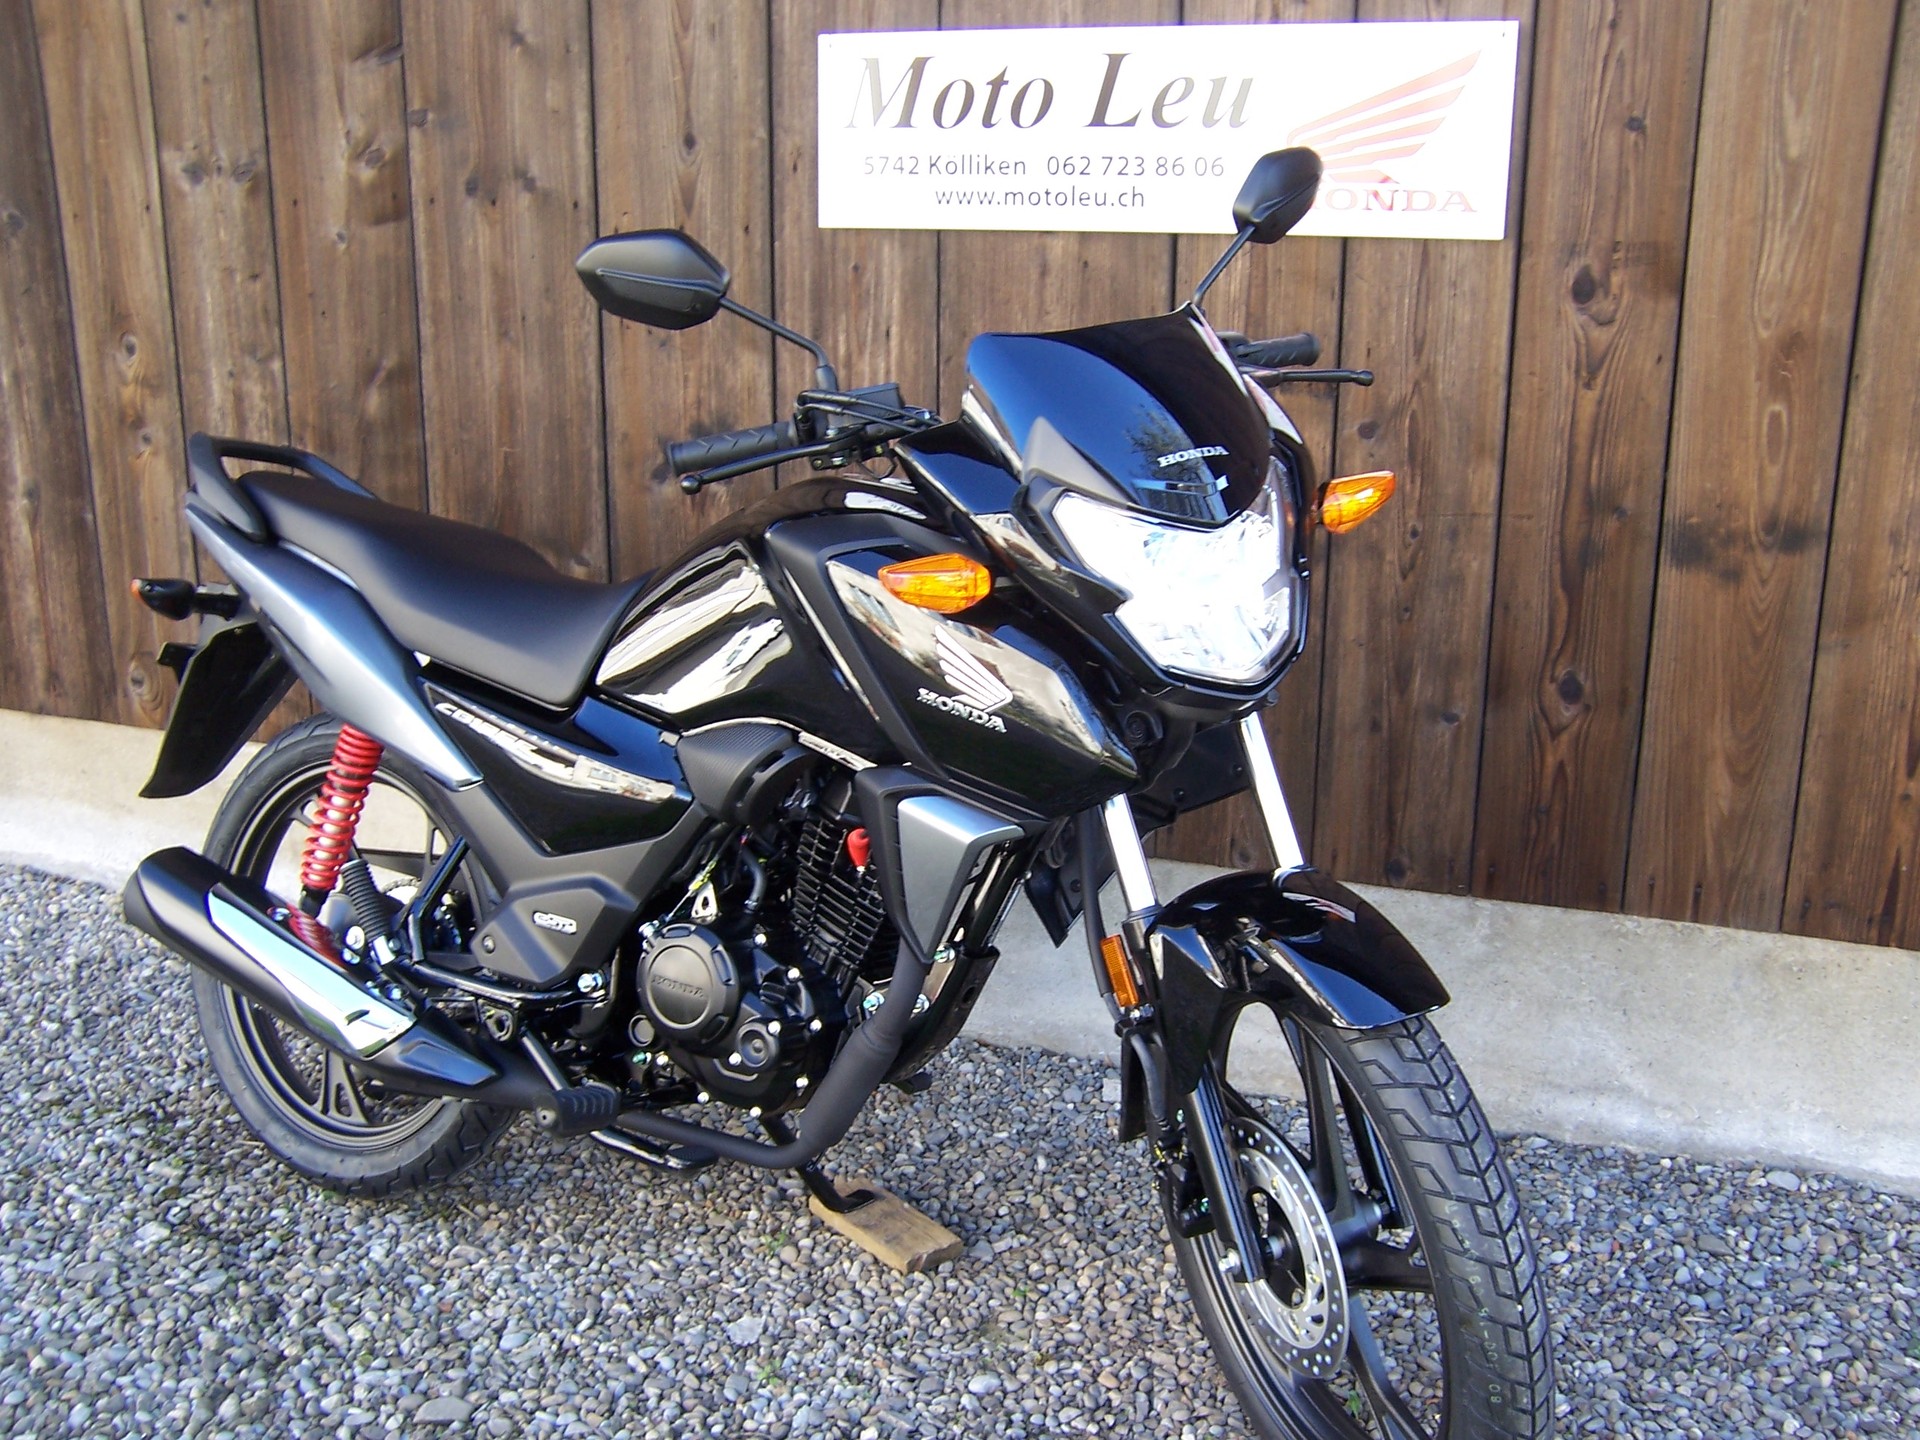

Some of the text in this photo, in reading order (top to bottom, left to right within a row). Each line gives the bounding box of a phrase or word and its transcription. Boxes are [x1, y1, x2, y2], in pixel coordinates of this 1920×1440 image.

[844, 52, 1254, 129] Moto Leu
[863, 155, 920, 176] 5742
[1046, 156, 1091, 176] 062
[1101, 156, 1146, 177] 723
[1155, 156, 1185, 177] 86
[1194, 156, 1225, 177] 06
[935, 185, 1145, 207] www.motoleu.ch
[1311, 187, 1478, 213] ONDA
[1157, 446, 1230, 468] HONDA
[916, 687, 1007, 733] HONDA
